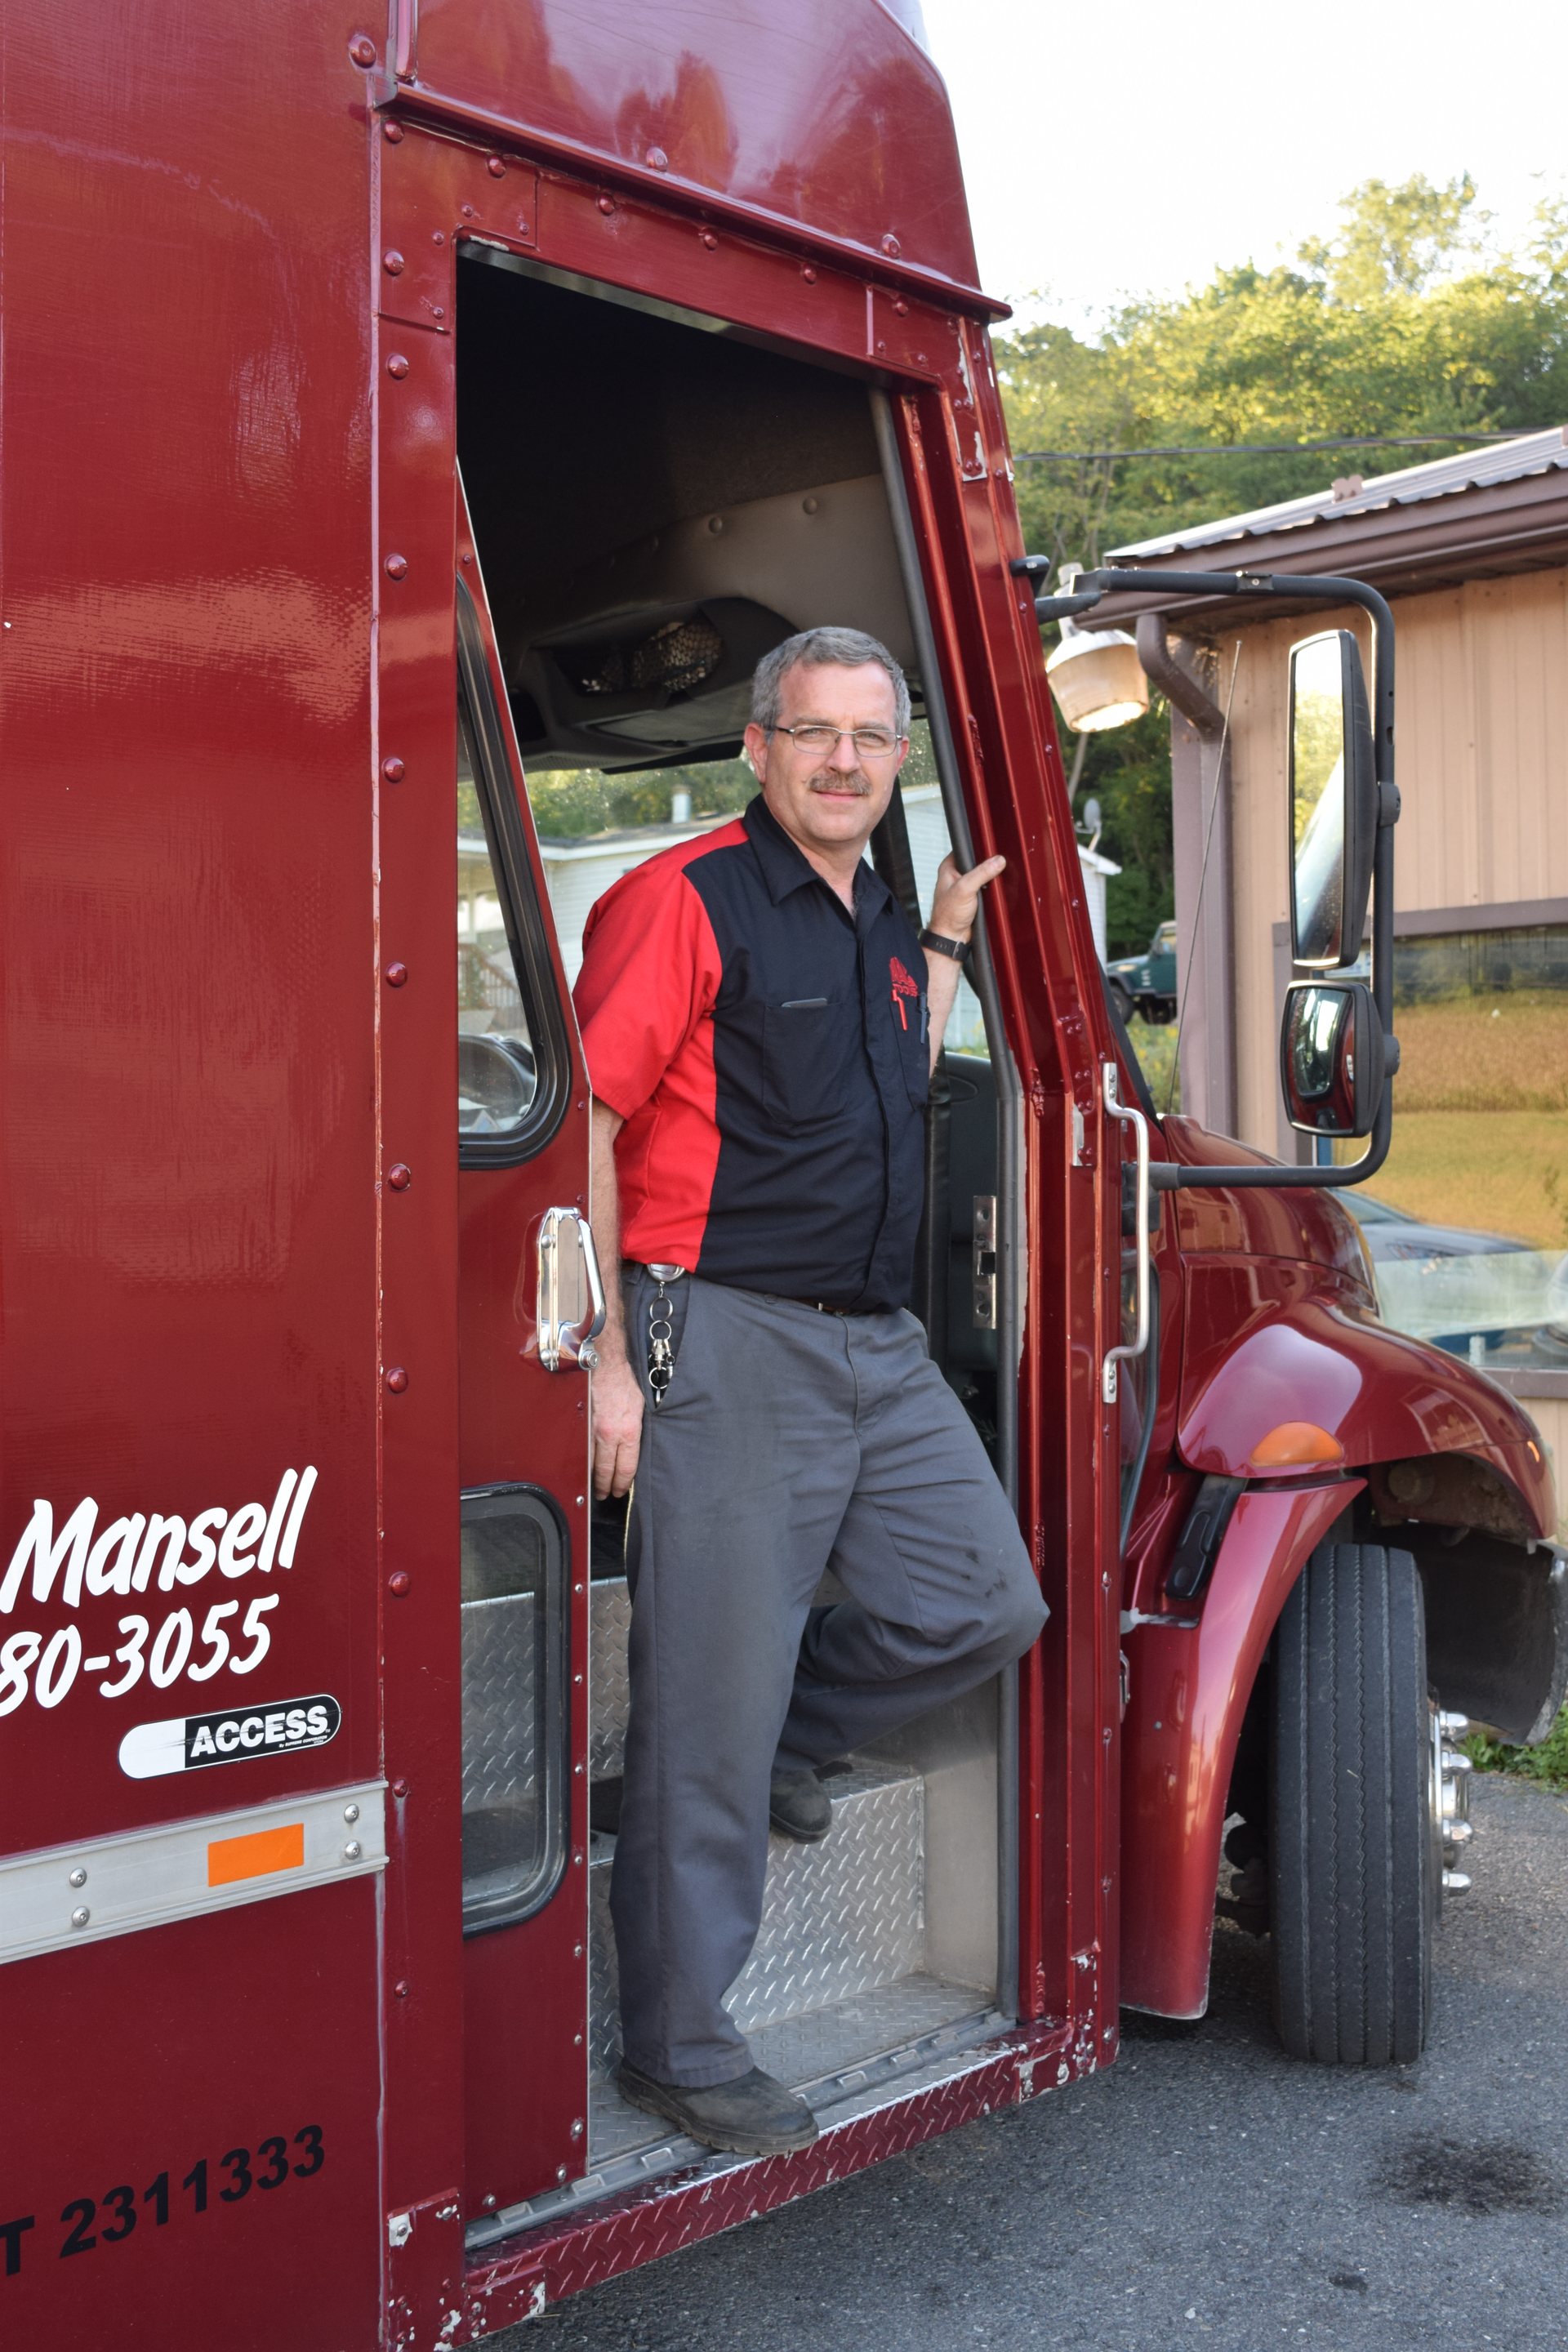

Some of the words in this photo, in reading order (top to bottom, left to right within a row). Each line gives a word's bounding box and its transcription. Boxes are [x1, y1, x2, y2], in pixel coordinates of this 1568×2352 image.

[0, 1465, 318, 1614] Mansell
[0, 1592, 280, 1717] 80-3055
[189, 1704, 328, 1757] ACCESS
[0, 2214, 35, 2277] T
[59, 2124, 326, 2260] 2311333
